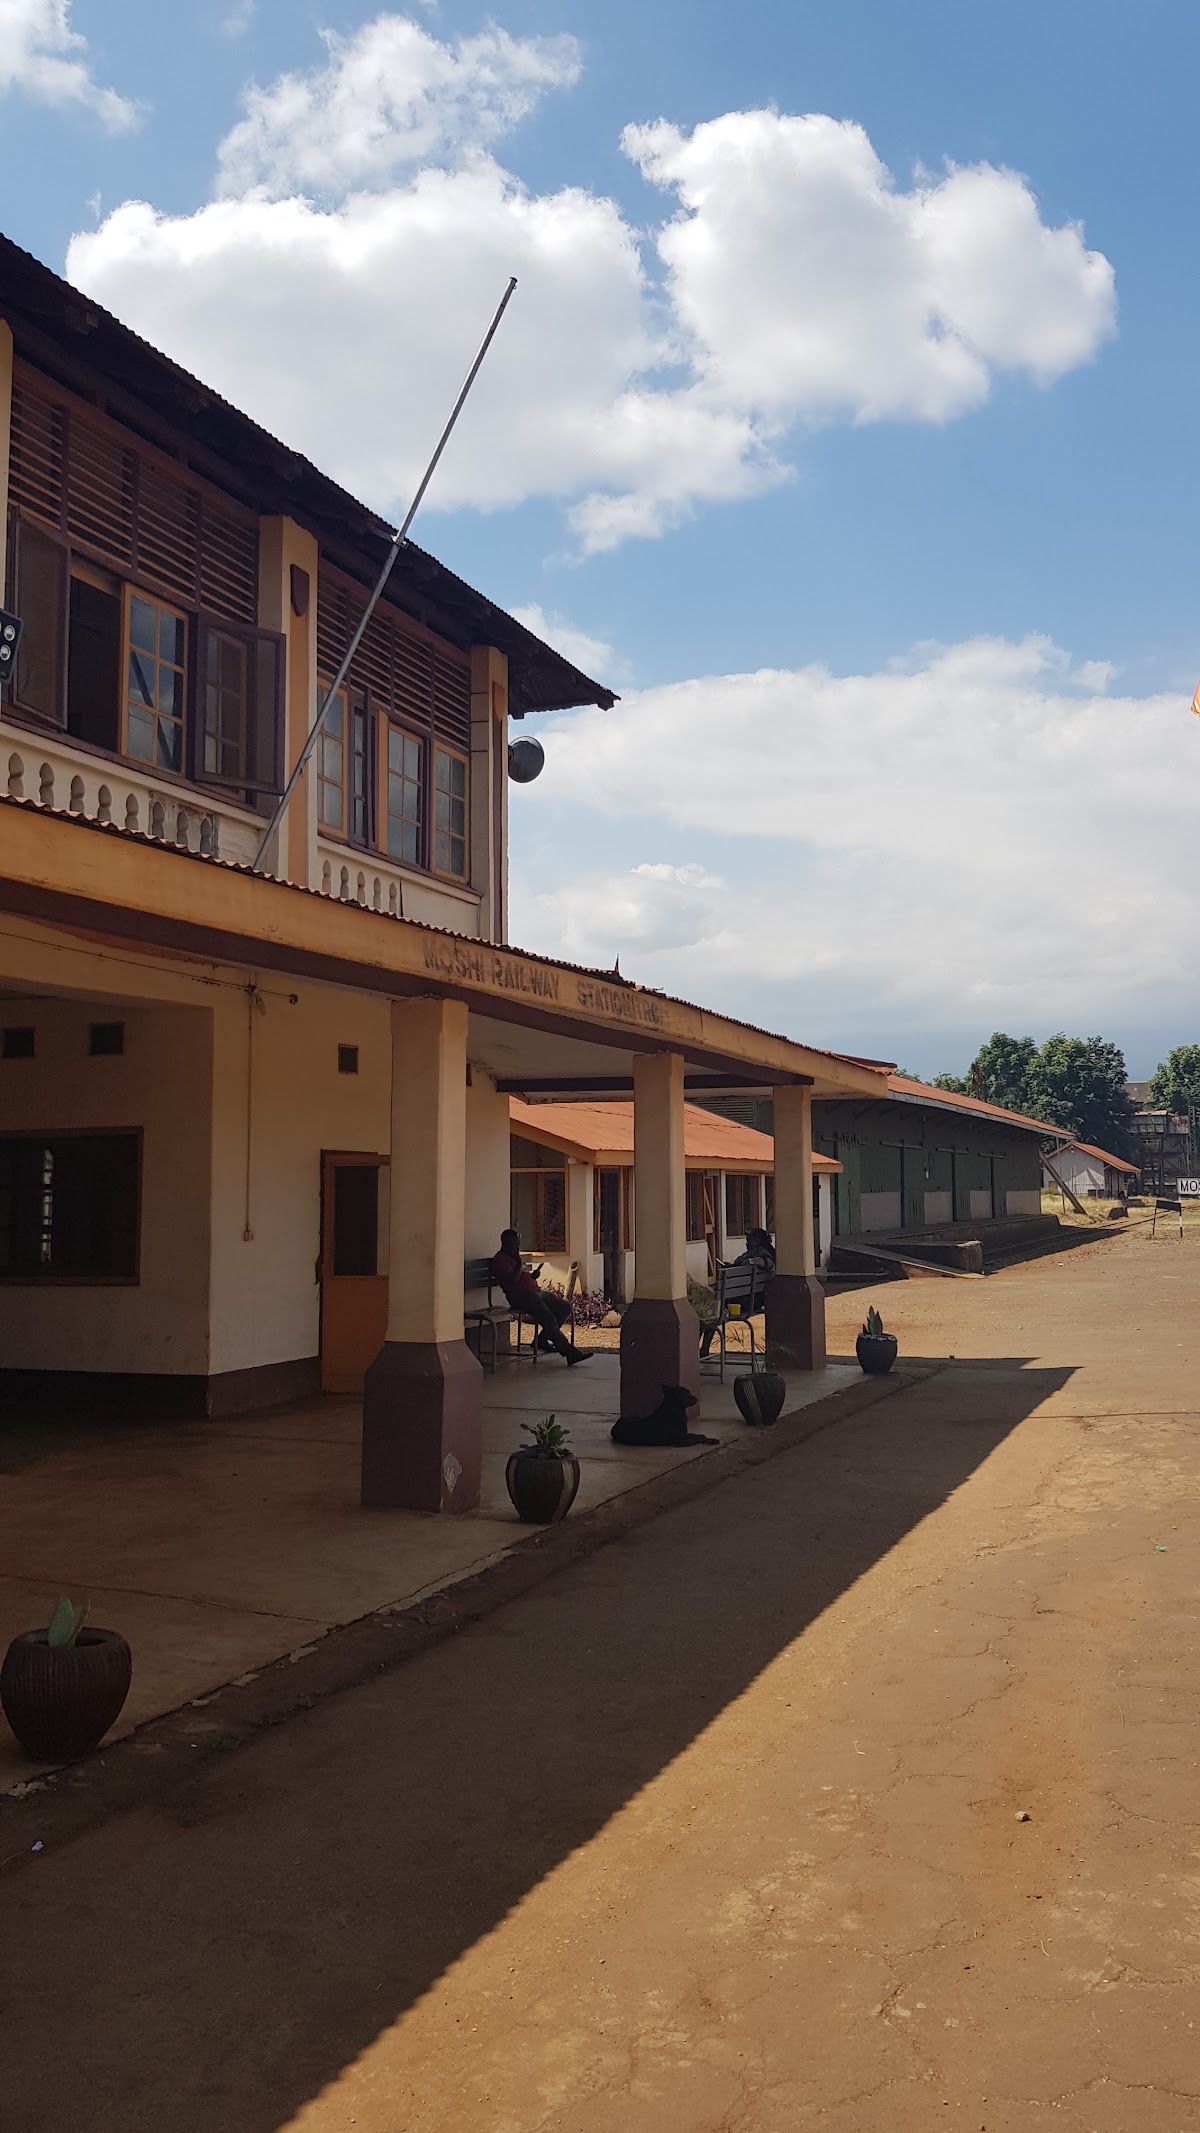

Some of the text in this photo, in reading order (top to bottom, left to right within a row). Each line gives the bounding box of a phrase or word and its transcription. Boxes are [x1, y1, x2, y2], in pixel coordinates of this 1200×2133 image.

[422, 938, 485, 984] MOSHI
[491, 954, 560, 1000] RAILWAY
[1180, 1180, 1200, 1192] MO
